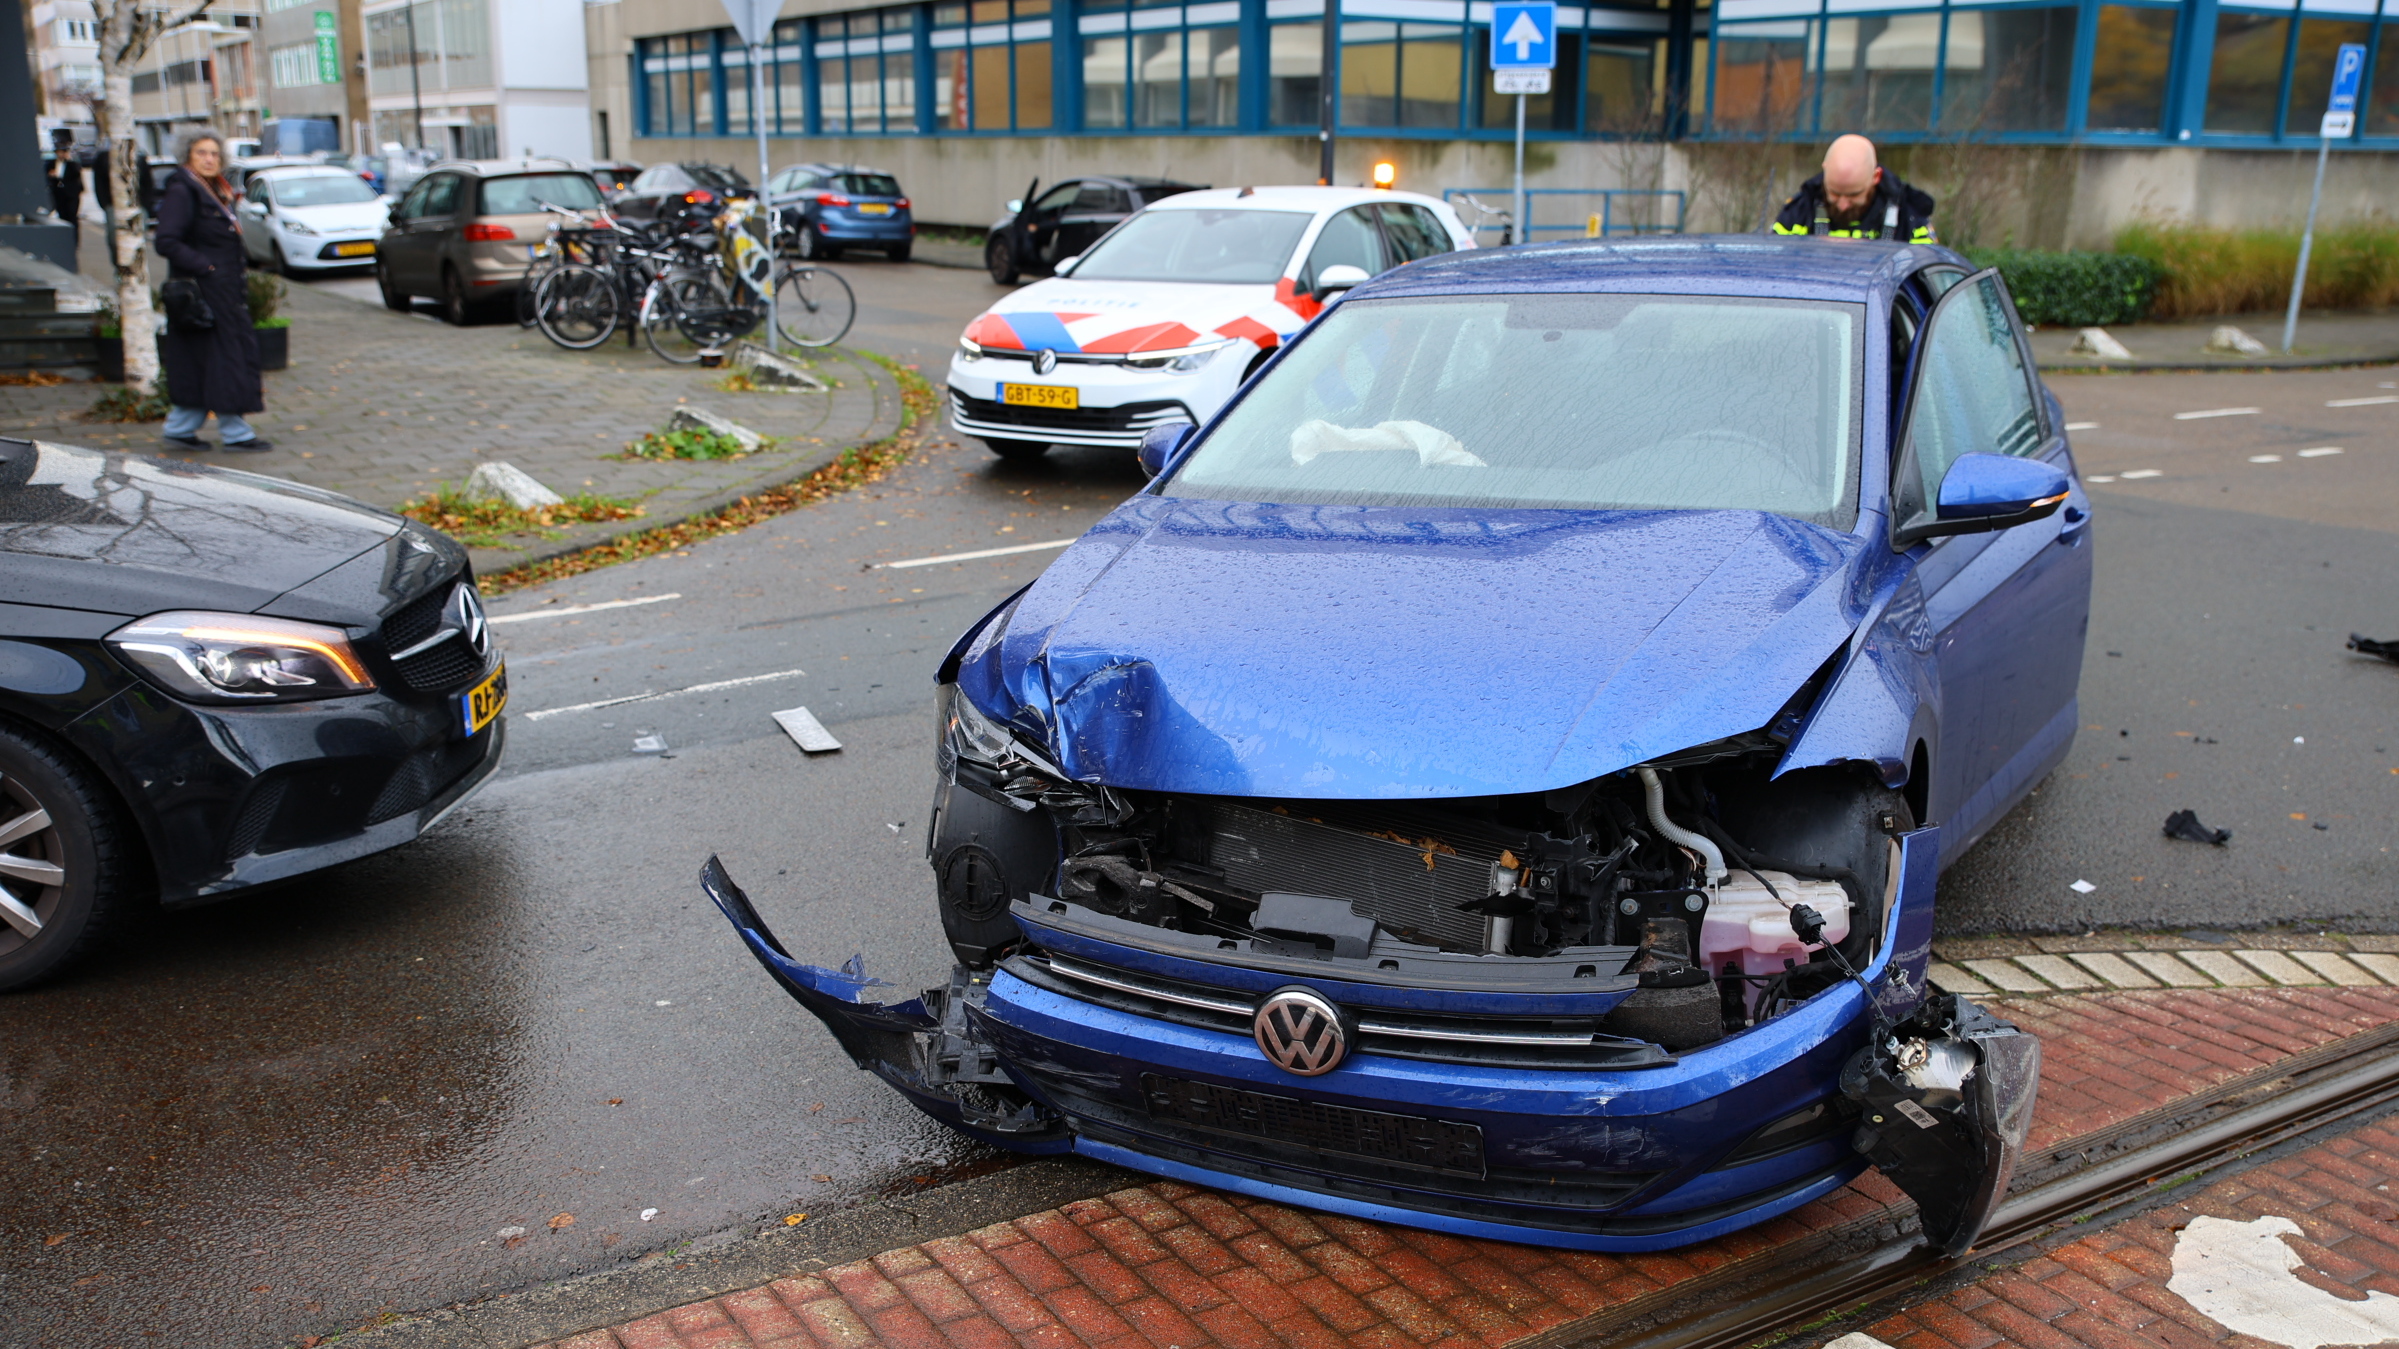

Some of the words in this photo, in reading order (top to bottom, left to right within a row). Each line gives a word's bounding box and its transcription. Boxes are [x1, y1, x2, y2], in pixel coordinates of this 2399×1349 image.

[2340, 51, 2359, 84] P
[1006, 385, 1072, 405] GBT-59-G
[1257, 1000, 1340, 1073] VW
